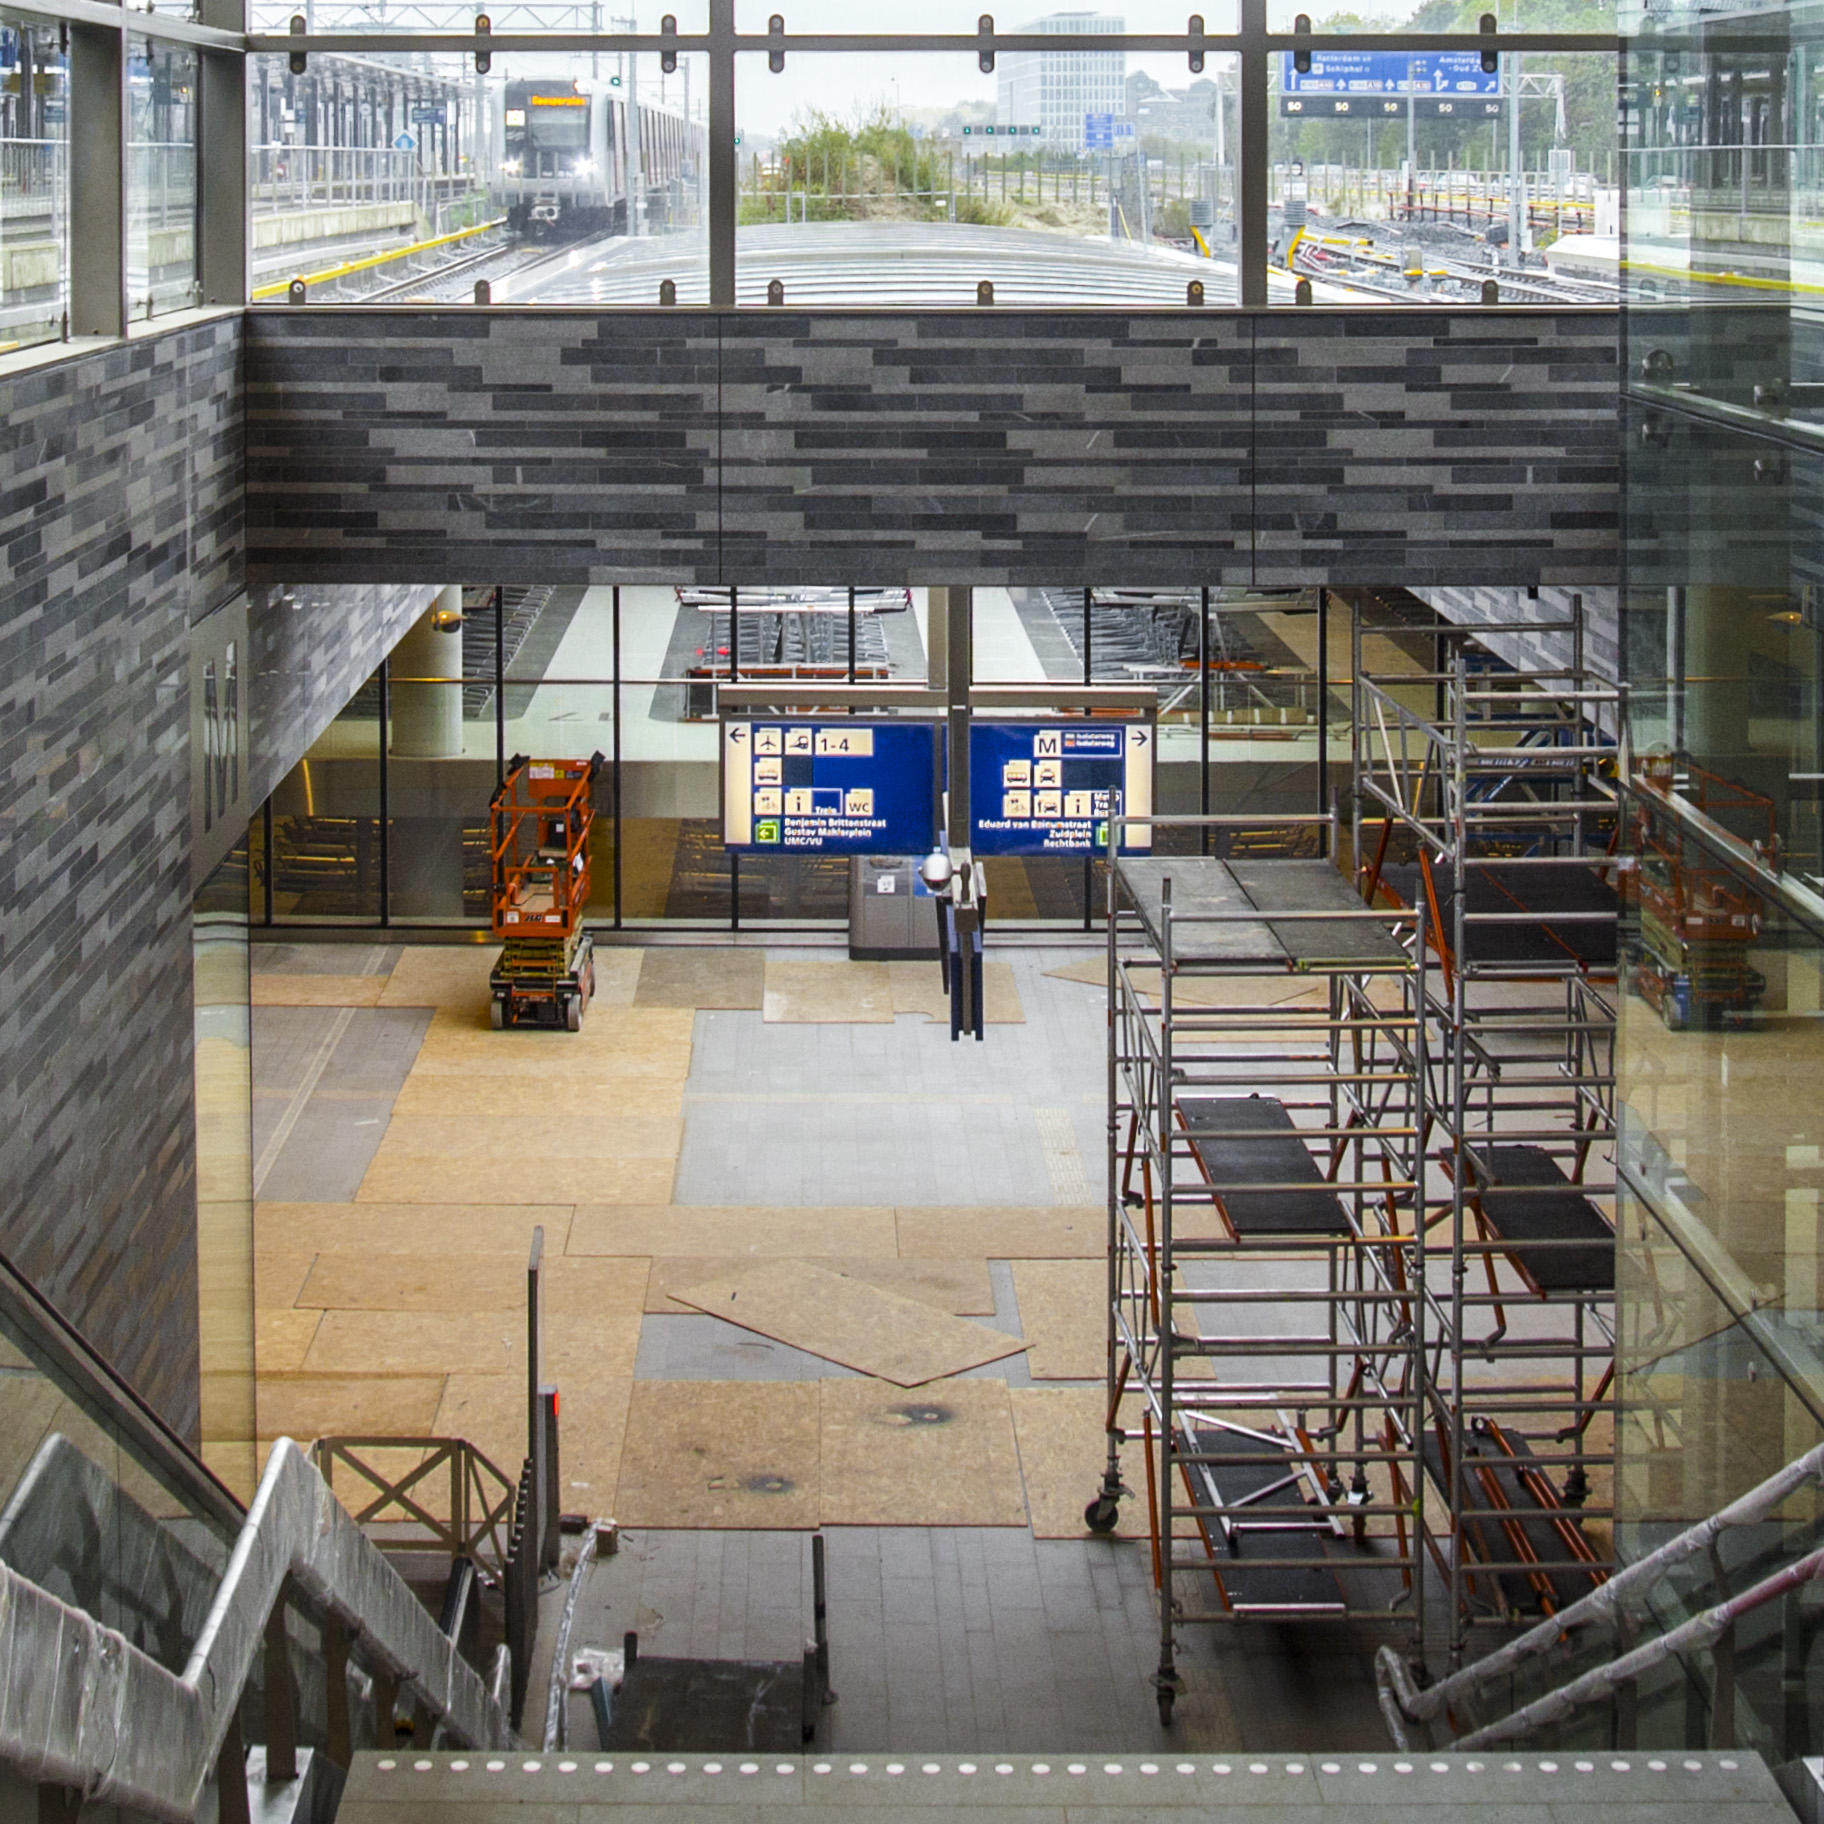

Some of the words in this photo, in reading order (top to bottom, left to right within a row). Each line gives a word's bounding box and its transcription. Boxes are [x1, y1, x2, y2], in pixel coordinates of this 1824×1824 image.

[1325, 64, 1363, 73] Schiphol
[1287, 101, 1302, 112] 50
[1335, 102, 1349, 112] 50
[1384, 102, 1398, 112] 50
[1439, 103, 1453, 113] 50
[1485, 104, 1499, 113] 50
[1038, 737, 1057, 754] M
[1094, 792, 1119, 801] Meto
[848, 802, 870, 813] WC
[784, 818, 827, 829] Benjamin
[828, 818, 886, 828] Brittenstraat
[978, 819, 1010, 829] Eduard
[1012, 820, 1029, 829] van
[784, 827, 816, 836] Gustav
[817, 827, 872, 838] Mahlerplein
[1049, 829, 1091, 840] Zuidplein
[784, 837, 823, 845] UMC/VU
[1043, 838, 1091, 848] Rechtbank
